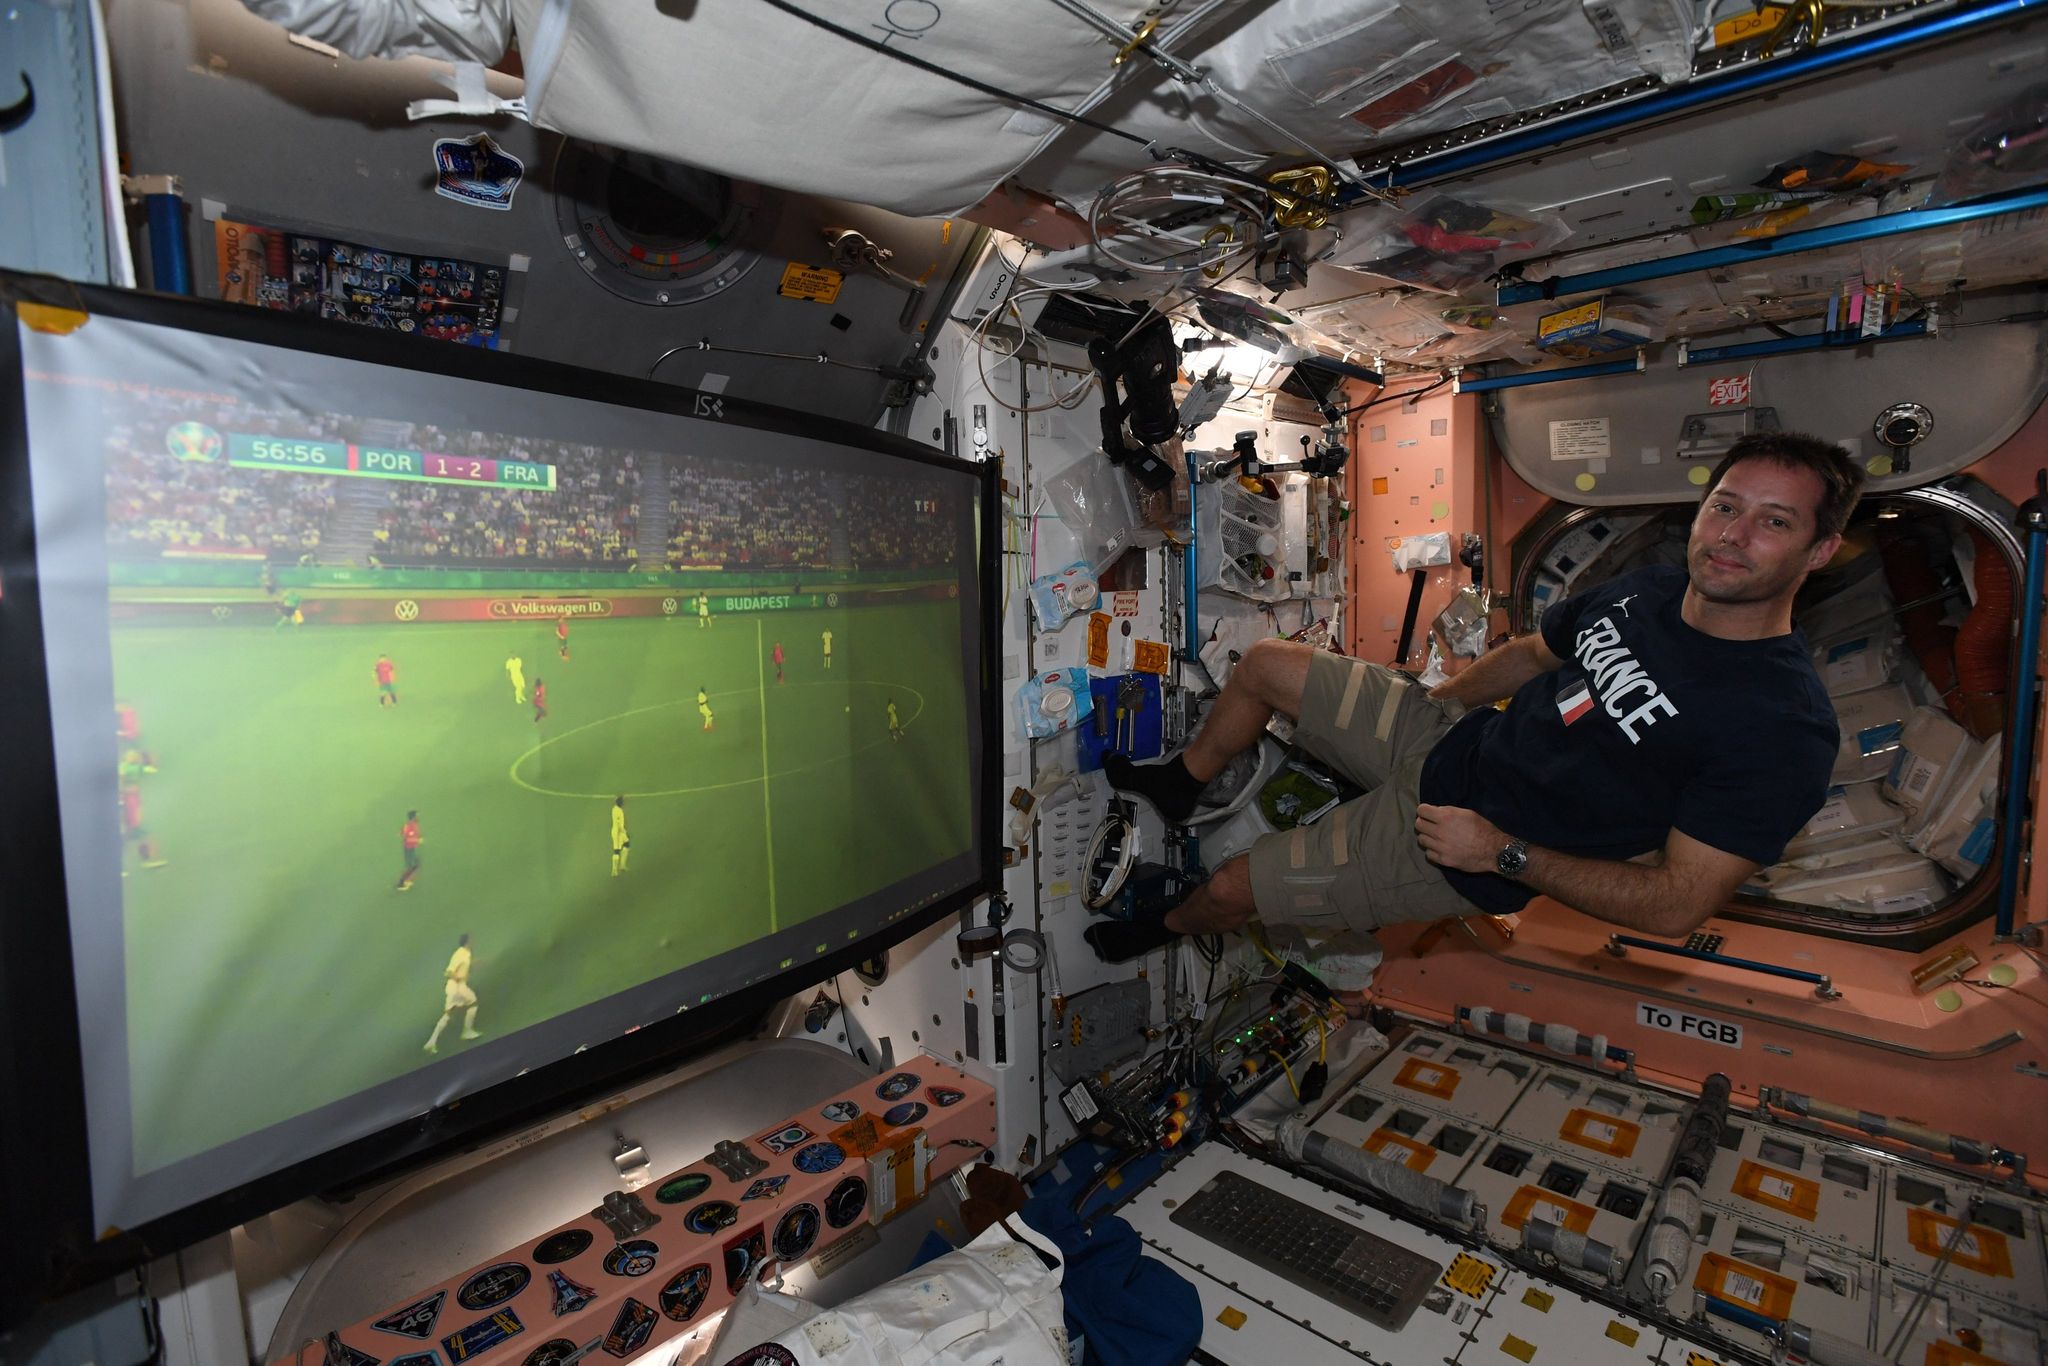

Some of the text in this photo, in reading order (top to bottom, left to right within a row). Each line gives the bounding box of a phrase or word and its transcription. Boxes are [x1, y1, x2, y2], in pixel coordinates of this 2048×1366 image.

[226, 227, 241, 274] APOLLO
[800, 271, 830, 283] WARNING
[360, 304, 411, 318] Challenger
[1714, 383, 1743, 399] EXIT
[251, 441, 327, 464] 56:56
[366, 451, 412, 472] POR
[503, 465, 540, 482] FRA
[511, 602, 605, 616] Volkswagen ID.
[725, 595, 791, 611] BUDAPEST
[1574, 616, 1680, 745] FRANCE
[1641, 1005, 1739, 1044] To FGB
[763, 1127, 807, 1152] 50
[400, 1308, 434, 1331] 46
